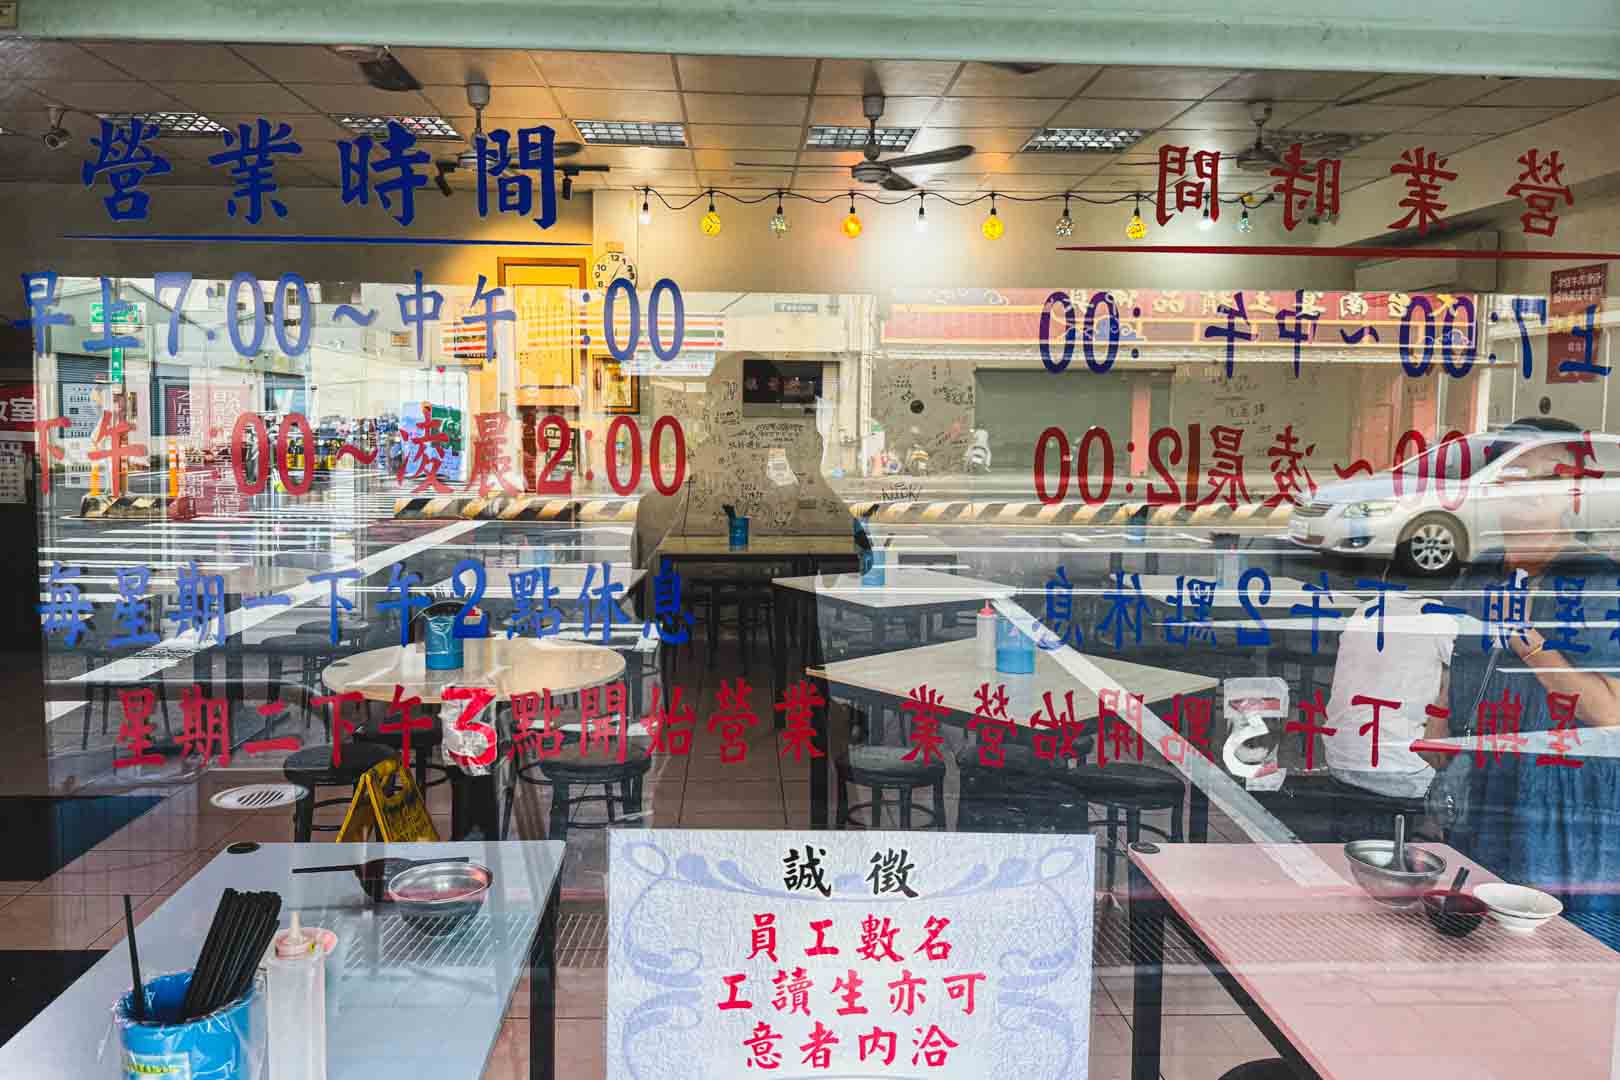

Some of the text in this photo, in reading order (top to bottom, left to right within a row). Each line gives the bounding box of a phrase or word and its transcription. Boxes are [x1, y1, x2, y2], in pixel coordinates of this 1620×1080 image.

[82, 117, 560, 230] 營業時間
[112, 677, 828, 769] 星期二下午3點開始營業
[782, 844, 920, 898] 誠徵
[744, 912, 954, 963] 員工數名
[716, 967, 987, 1017] 工讀生亦可
